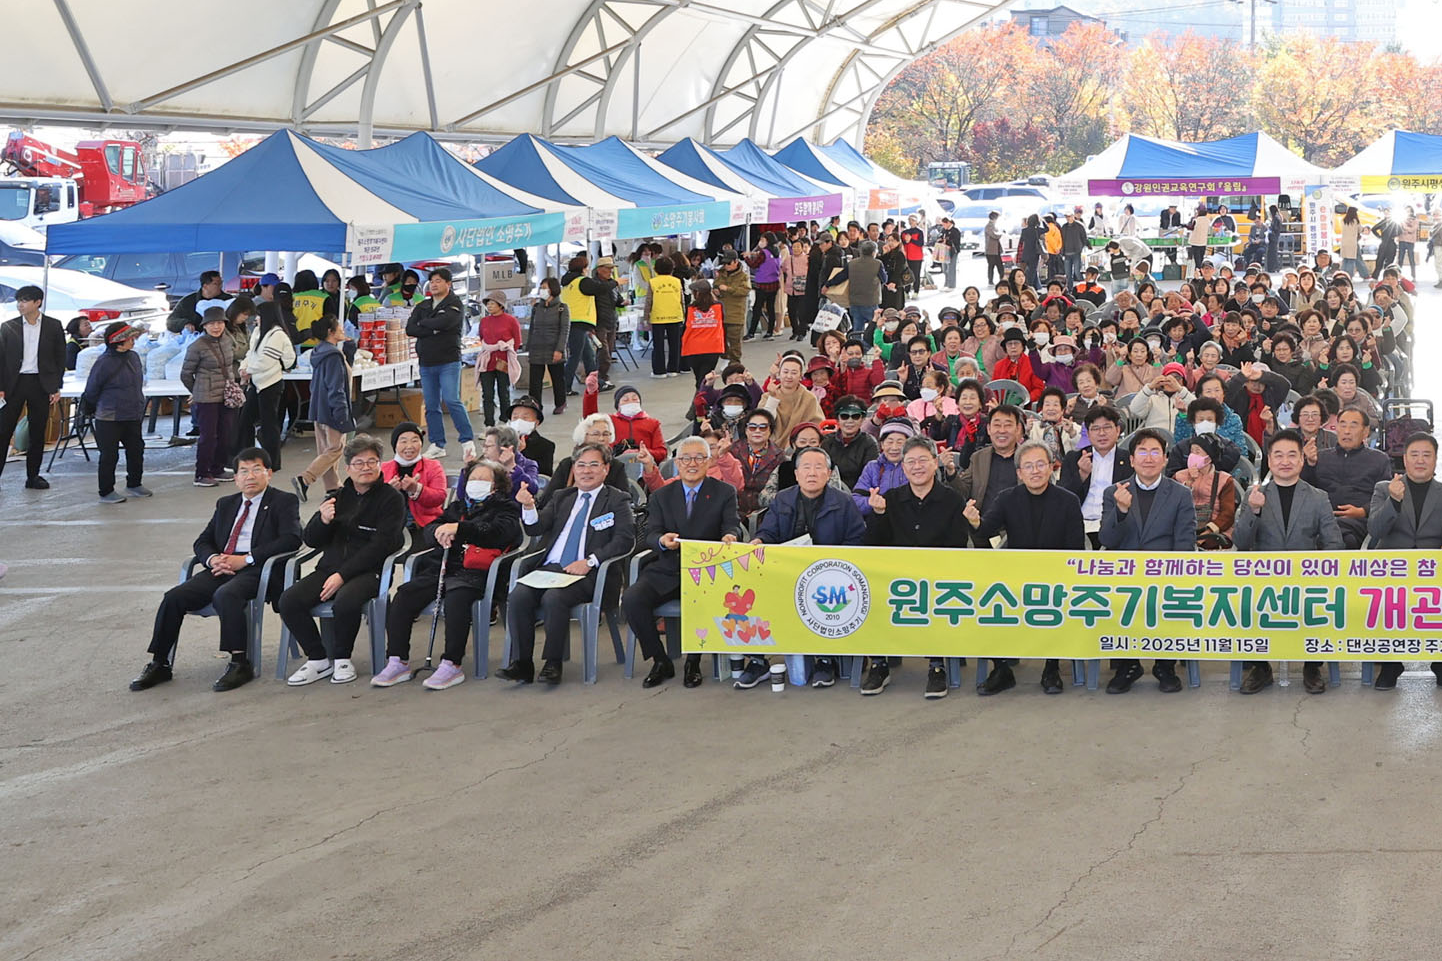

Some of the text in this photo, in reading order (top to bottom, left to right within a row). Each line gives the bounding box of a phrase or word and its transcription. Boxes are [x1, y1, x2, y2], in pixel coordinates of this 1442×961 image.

[1134, 182, 1215, 193] 강원인권교육연구회
[455, 222, 533, 248] 사단법인 소망주기
[806, 560, 853, 577] CORPORATION
[1067, 558, 1136, 576] “나눔과
[1144, 558, 1224, 576] 함께하는
[1233, 558, 1292, 577] 당신이
[1301, 558, 1339, 577] 있어
[1348, 559, 1408, 577] 세상은
[1417, 559, 1437, 577] 참
[812, 585, 848, 605] SM
[888, 579, 1346, 629] 원주소망주기복지센터
[1204, 637, 1233, 653] 11월
[1236, 638, 1269, 653] 15일
